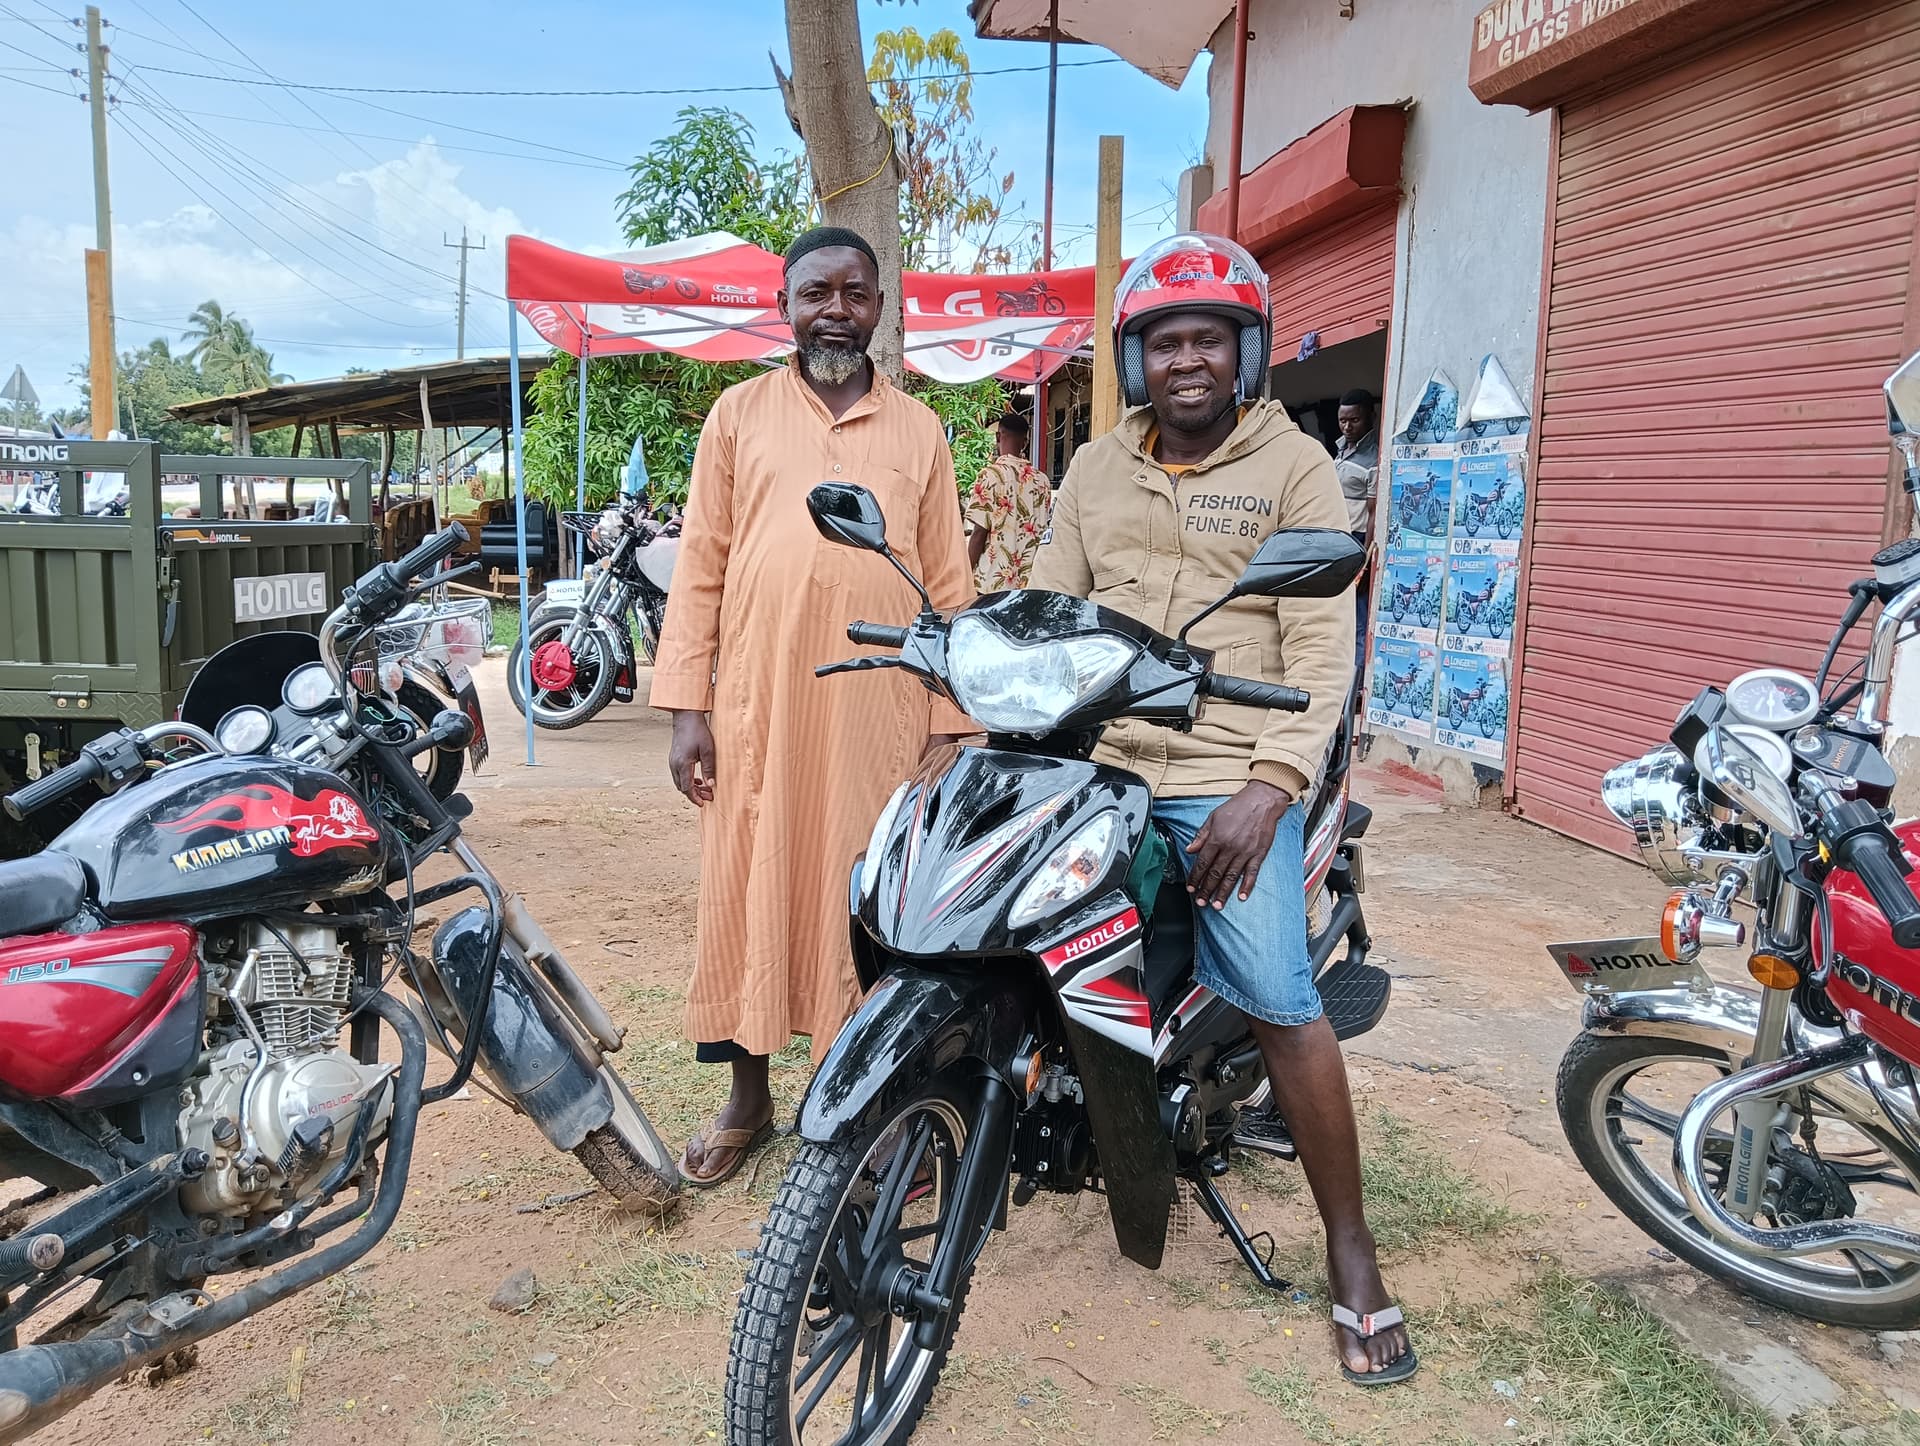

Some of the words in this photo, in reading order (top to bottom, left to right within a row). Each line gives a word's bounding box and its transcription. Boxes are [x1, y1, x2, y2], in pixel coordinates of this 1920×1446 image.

[1477, 0, 1544, 51] DUKA
[1498, 11, 1569, 67] GLASS
[1170, 272, 1215, 283] HONLG
[711, 294, 758, 304] HONLG
[1188, 494, 1273, 516] FISHION
[216, 533, 241, 543] HONLG
[235, 576, 325, 617] HONLG
[171, 825, 291, 873] KINGLION
[1064, 920, 1126, 958] HONLG
[8, 958, 71, 983] 150
[1590, 952, 1692, 971] HONL
[1735, 1147, 1752, 1193] HONLG
